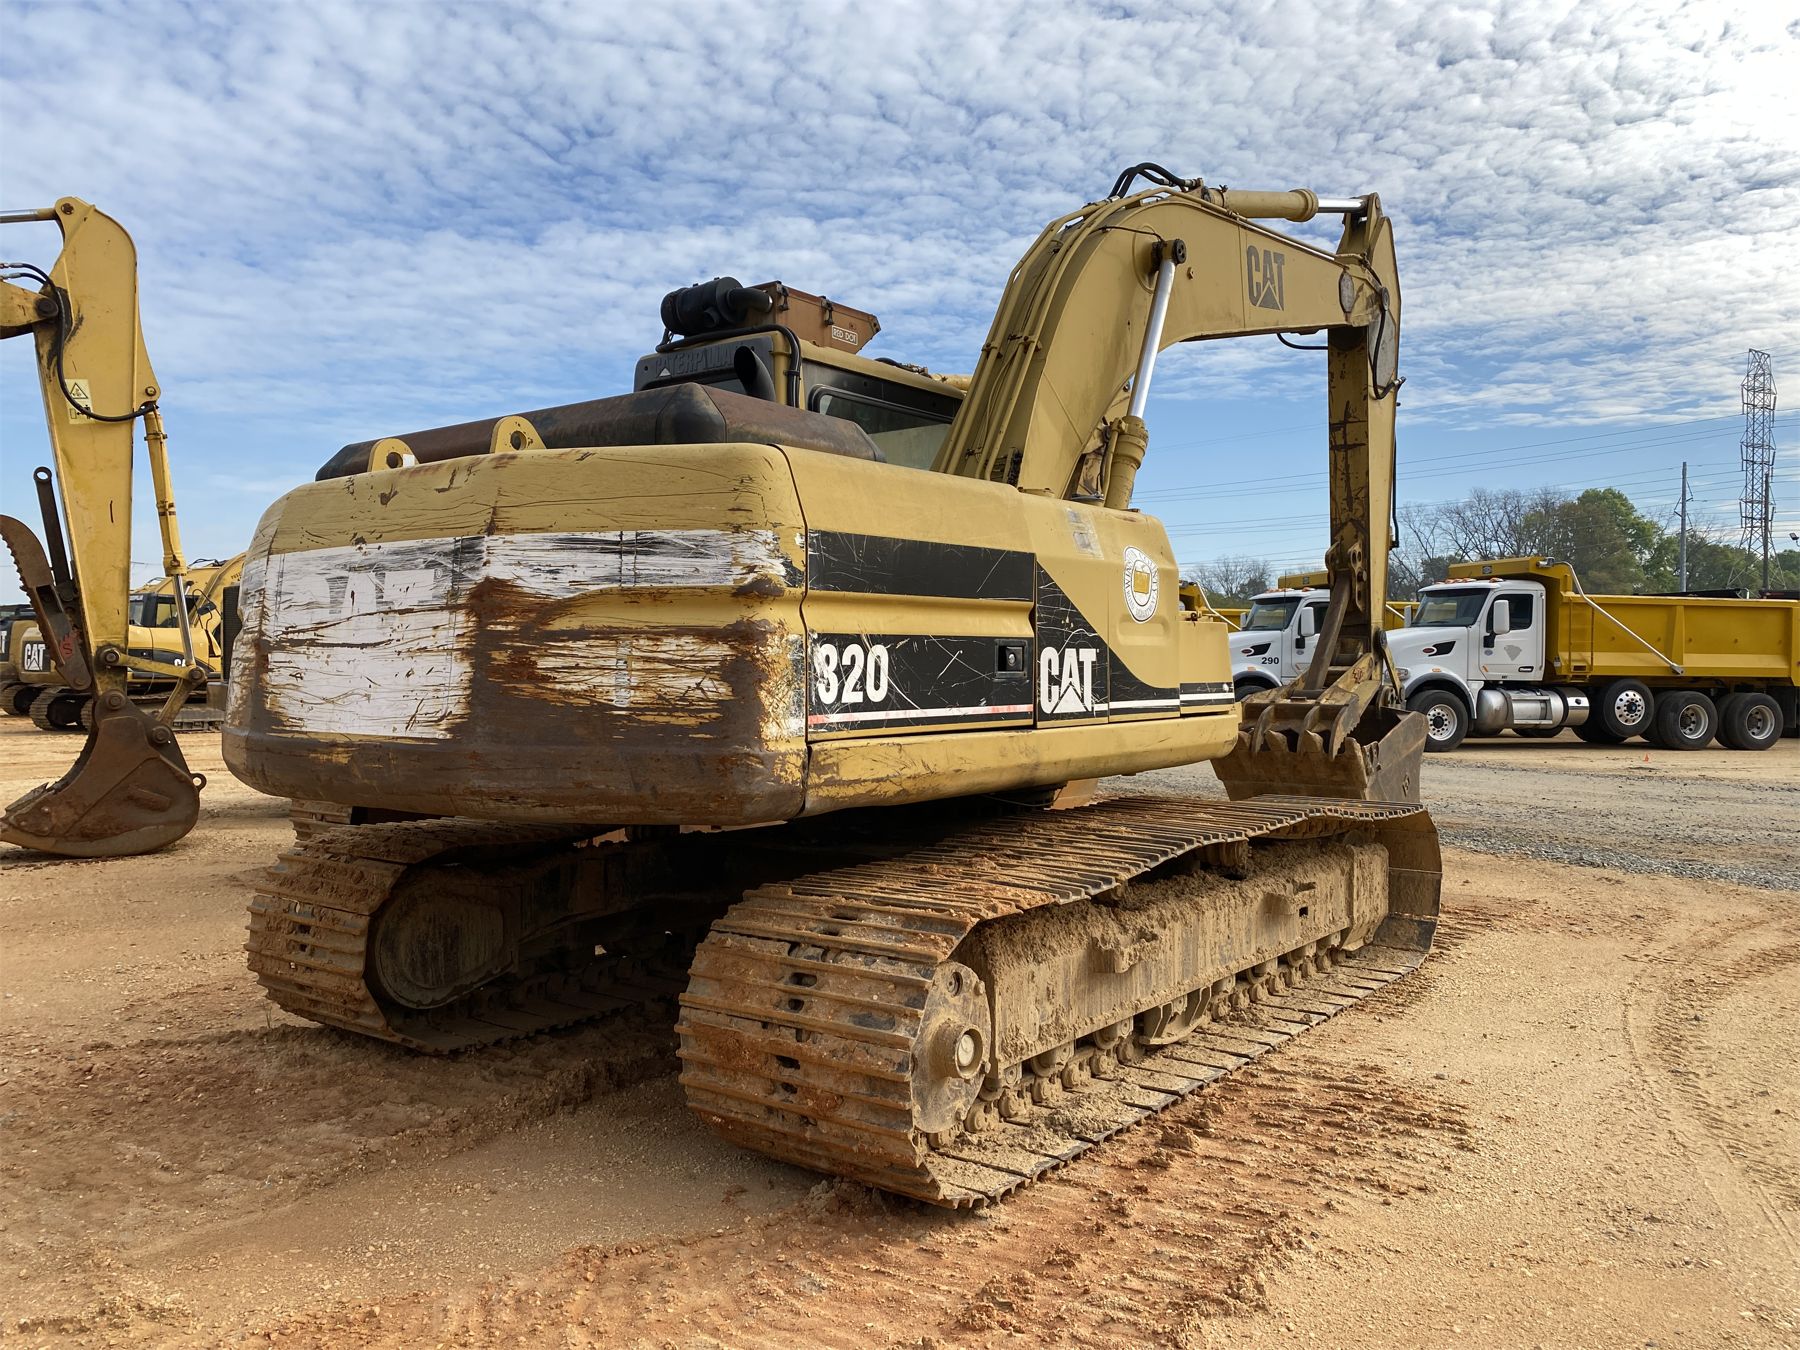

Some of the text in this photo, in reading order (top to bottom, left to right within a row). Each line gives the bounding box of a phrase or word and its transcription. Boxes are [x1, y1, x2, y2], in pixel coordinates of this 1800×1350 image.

[1246, 245, 1285, 311] CAT
[655, 345, 735, 378] CATERPILLA
[24, 643, 46, 671] CAT
[1261, 657, 1280, 665] 290
[1040, 646, 1096, 714] CAT
